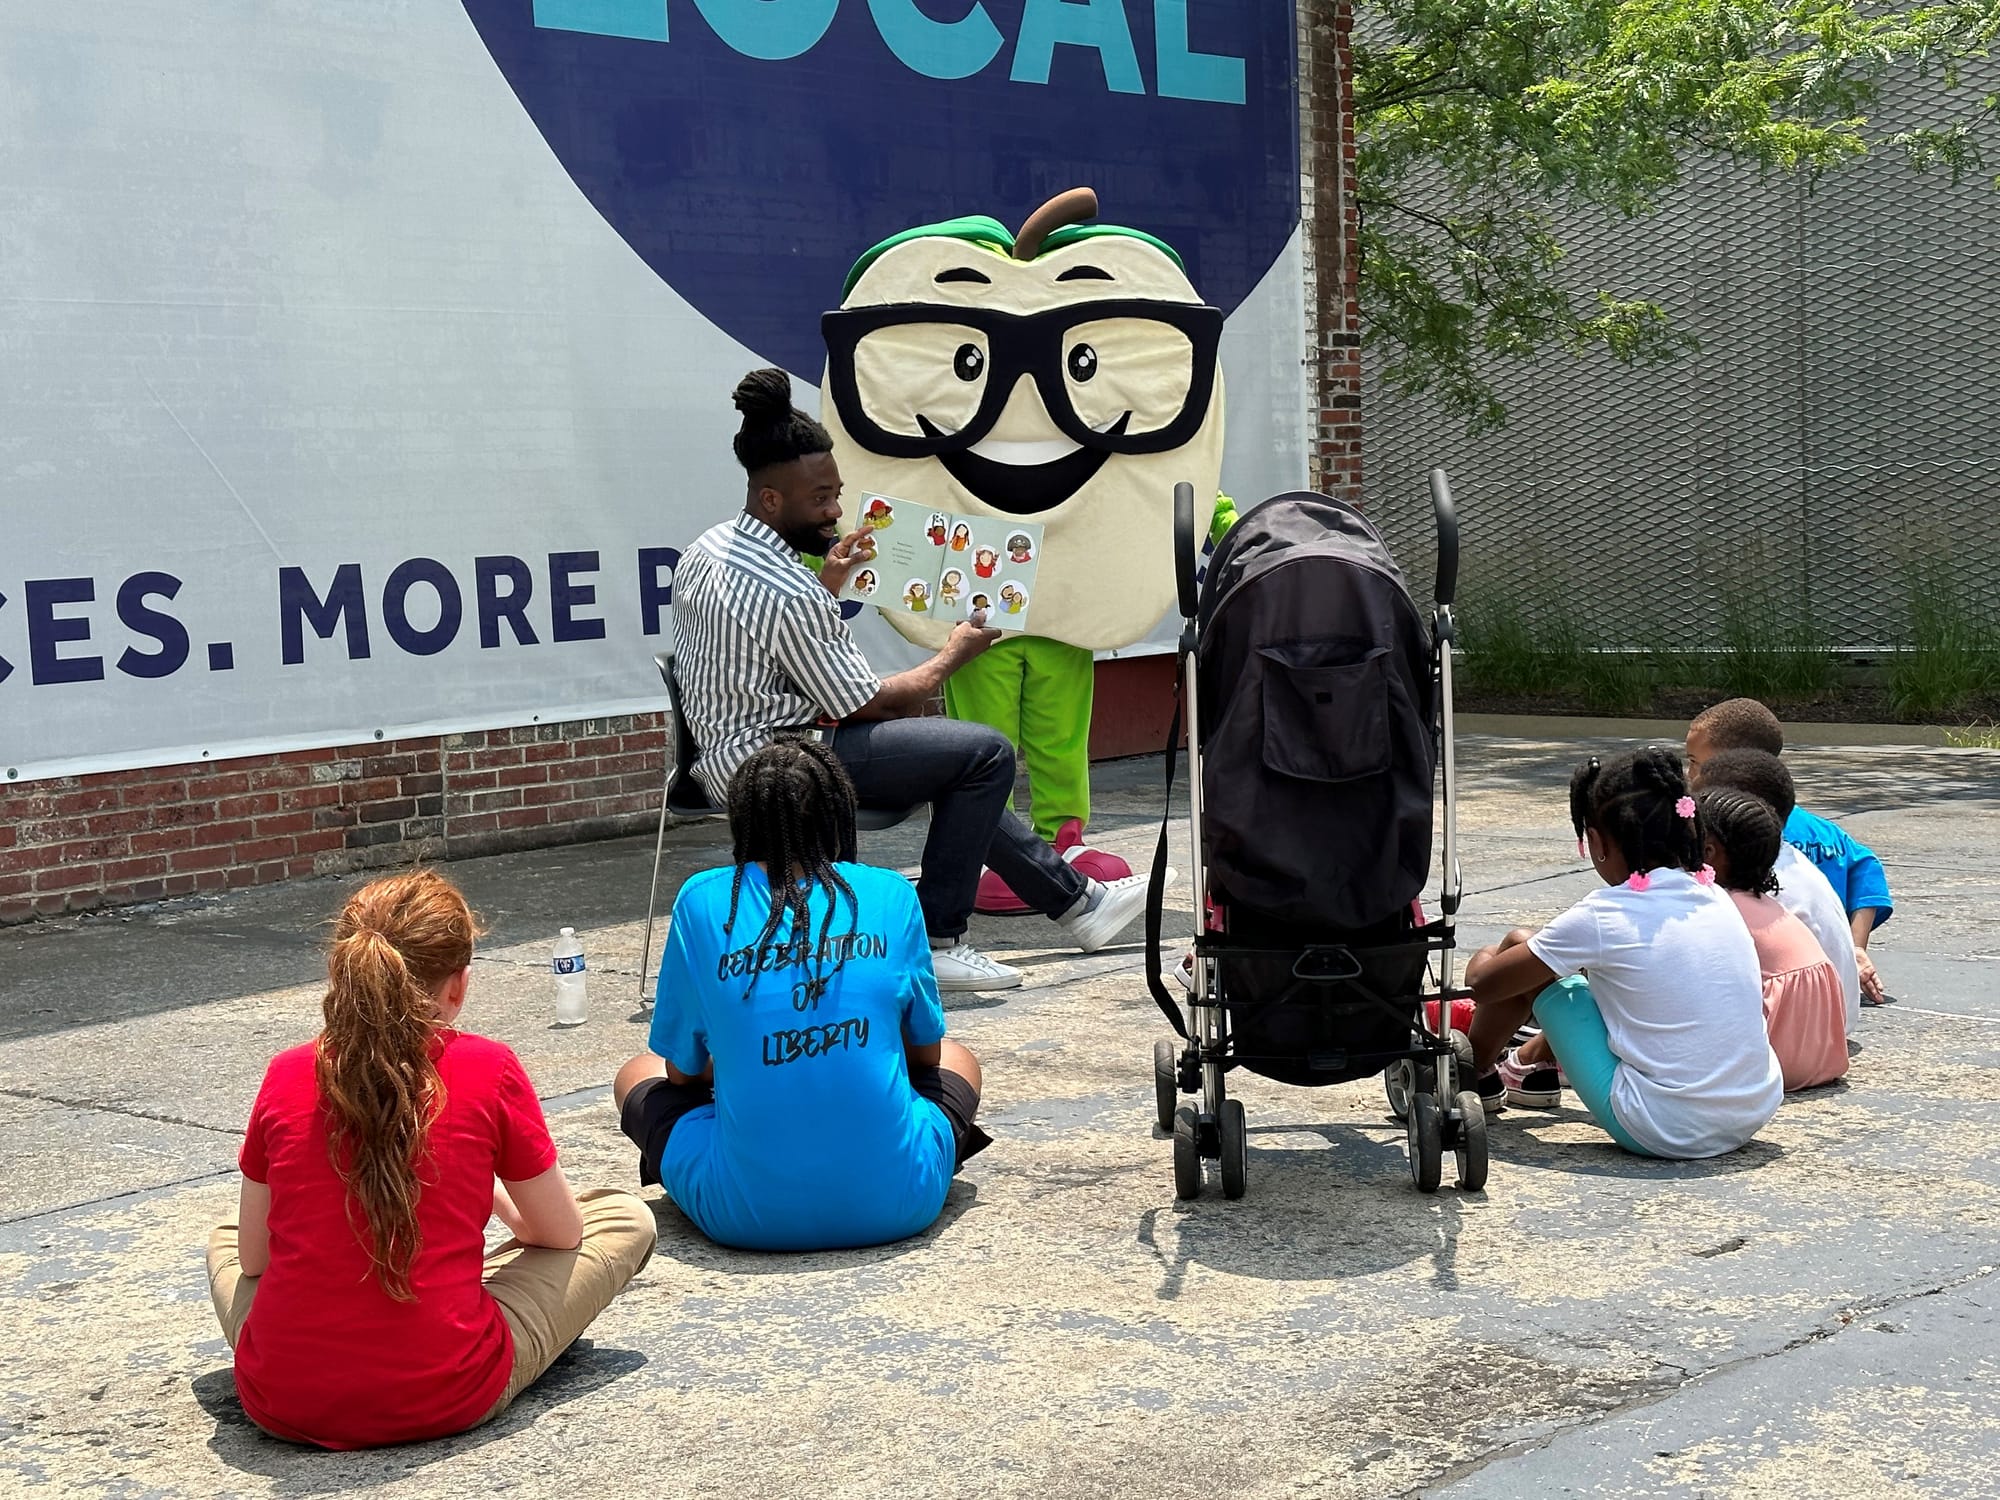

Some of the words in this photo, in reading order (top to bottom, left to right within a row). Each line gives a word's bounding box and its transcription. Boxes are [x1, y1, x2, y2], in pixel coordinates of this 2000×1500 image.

[533, 0, 1246, 105] CAL
[0, 571, 234, 686] ES.
[279, 550, 606, 665] MORE
[761, 1016, 870, 1067] LIBERTY
